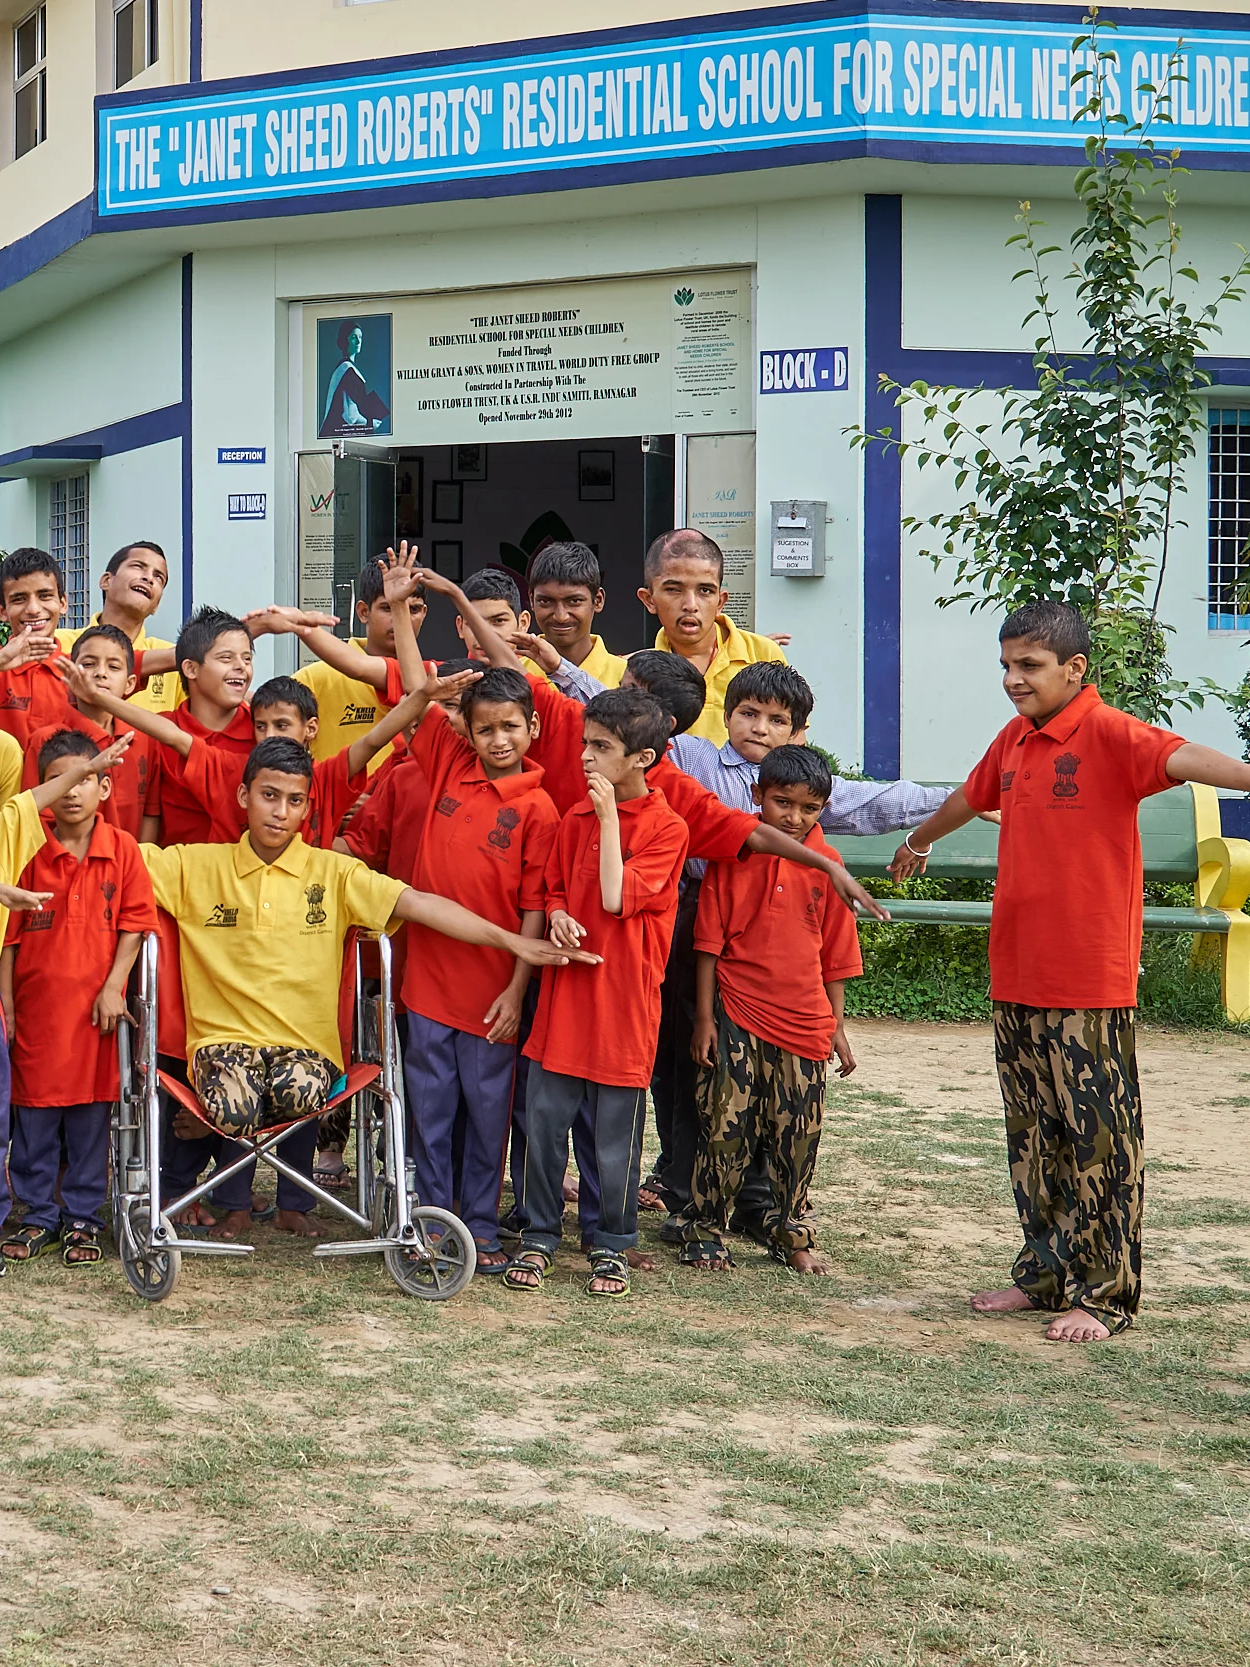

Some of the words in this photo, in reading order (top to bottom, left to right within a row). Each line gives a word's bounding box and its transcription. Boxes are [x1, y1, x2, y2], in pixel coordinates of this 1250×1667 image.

[115, 125, 161, 192] THE
[168, 112, 258, 187] "JANET
[264, 103, 347, 176] SHEED
[357, 84, 493, 166] ROBERTS"
[502, 61, 688, 150] RESIDENTIAL
[698, 45, 823, 130] SCHOOL
[833, 38, 894, 116] FOR
[903, 39, 1022, 120] SPECIAL
[1032, 46, 1121, 123] NEEDS
[490, 315, 513, 326] JANET
[515, 313, 540, 325] SHEED
[429, 333, 477, 347] RESIDENTIAL
[479, 331, 507, 343] SCHOOL
[509, 329, 524, 341] FOR
[526, 327, 556, 340] SPECIAL
[558, 326, 583, 338] NEEDS
[584, 322, 624, 336] CHILDREN
[498, 347, 522, 358] Funded
[524, 345, 552, 357] Through
[397, 368, 429, 380] WILLIAM
[431, 367, 455, 379] GRANT
[457, 367, 462, 377] &
[486, 363, 514, 375] WOMEN
[516, 362, 524, 373] IN
[559, 357, 587, 370] WORLD
[589, 356, 610, 368] DUTY
[611, 354, 631, 366] FREE
[633, 352, 660, 365] GROUP
[762, 352, 816, 390] BLOCK
[822, 370, 829, 379] -
[834, 351, 846, 387] D
[465, 380, 503, 392] Constructed
[505, 379, 512, 390] In
[514, 377, 553, 390] Partnership
[555, 376, 572, 386] With
[573, 375, 586, 385] The
[418, 399, 440, 411] LOTUS
[442, 397, 472, 409] FLOWER
[501, 395, 511, 405] UK
[513, 394, 519, 404] &
[542, 391, 560, 403] INDU
[594, 387, 637, 400] RAMNAGAR
[479, 412, 502, 425] Opened
[504, 410, 536, 422] November
[538, 409, 554, 420] 29th
[555, 408, 572, 418] 2012
[222, 451, 262, 461] RECEPTION
